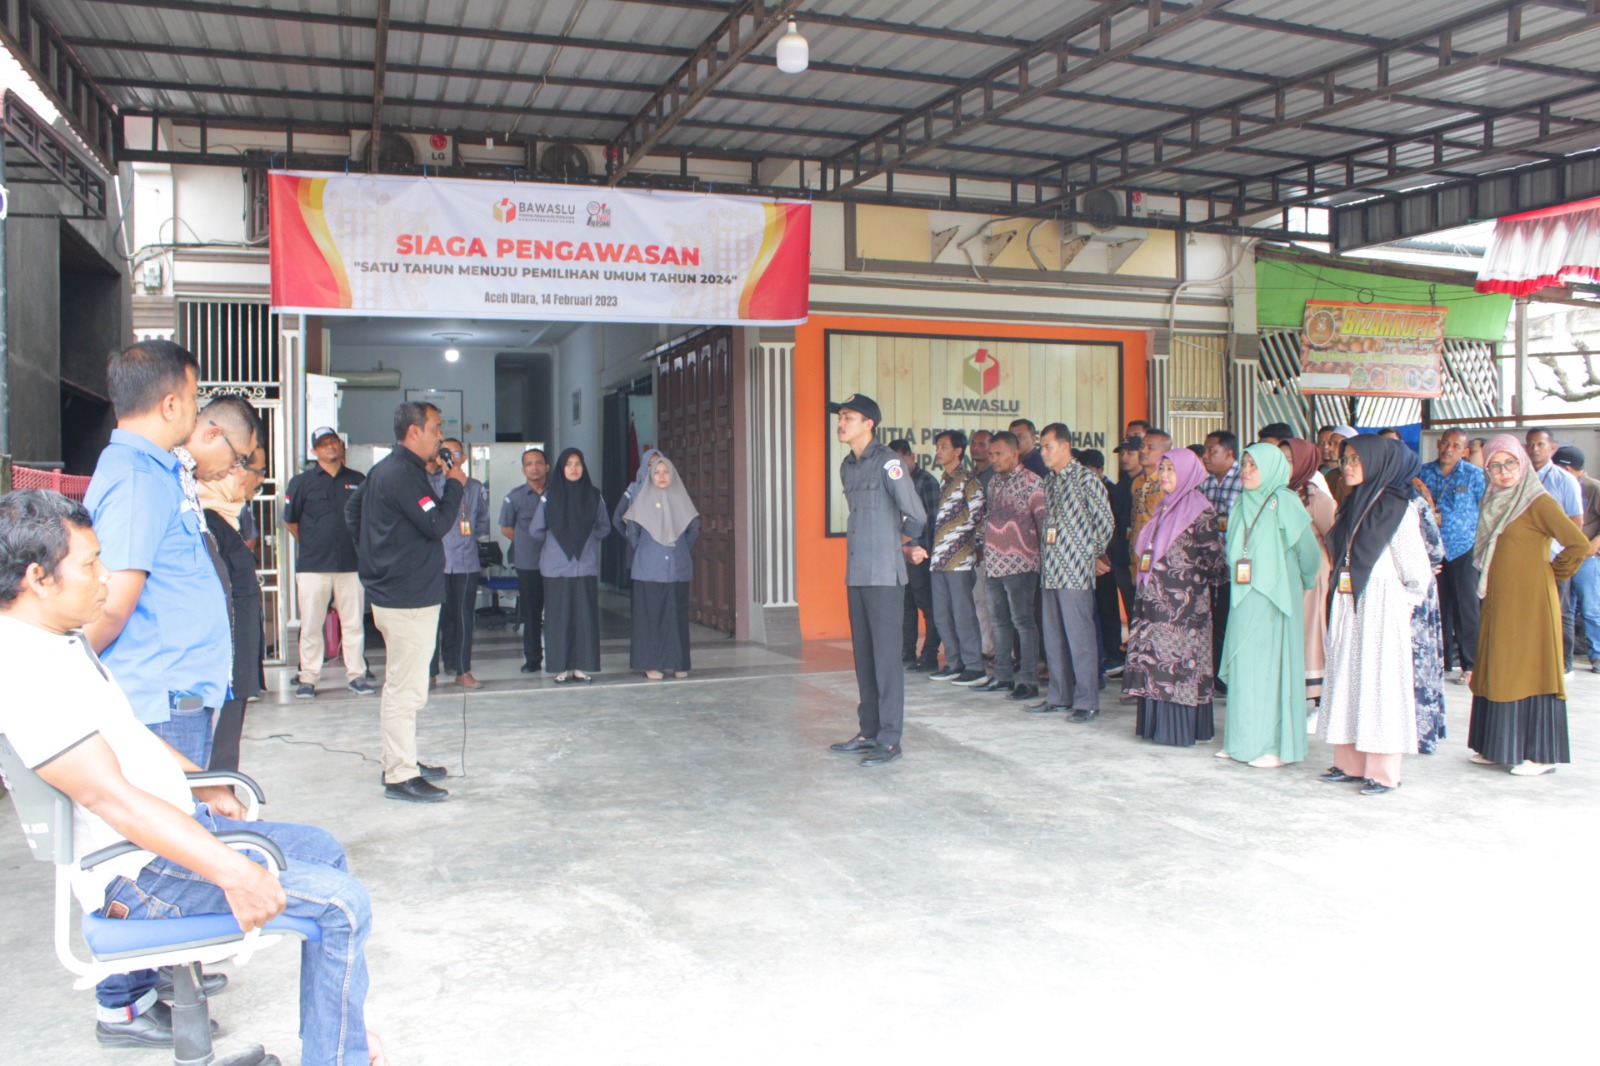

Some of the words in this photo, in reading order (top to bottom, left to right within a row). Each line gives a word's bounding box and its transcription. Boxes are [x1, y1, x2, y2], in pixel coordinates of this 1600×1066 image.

[431, 152, 446, 161] LG
[518, 202, 576, 215] BAWASLU
[396, 234, 488, 258] SIAGA
[496, 238, 700, 267] PENGAWASAN
[354, 261, 400, 273] "SATU
[403, 262, 454, 275] TAHUN
[458, 265, 518, 277] MENUJU
[522, 267, 599, 280] PEMILIHAN
[604, 271, 646, 282] UMUM
[650, 272, 697, 284] TAHUN
[700, 274, 737, 285] 2024"
[484, 291, 508, 304] Aceh
[511, 293, 539, 306] Utara,
[541, 293, 552, 305] 14
[553, 294, 592, 306] Februari
[595, 295, 618, 307] 2023
[942, 397, 1020, 412] BAWASLU
